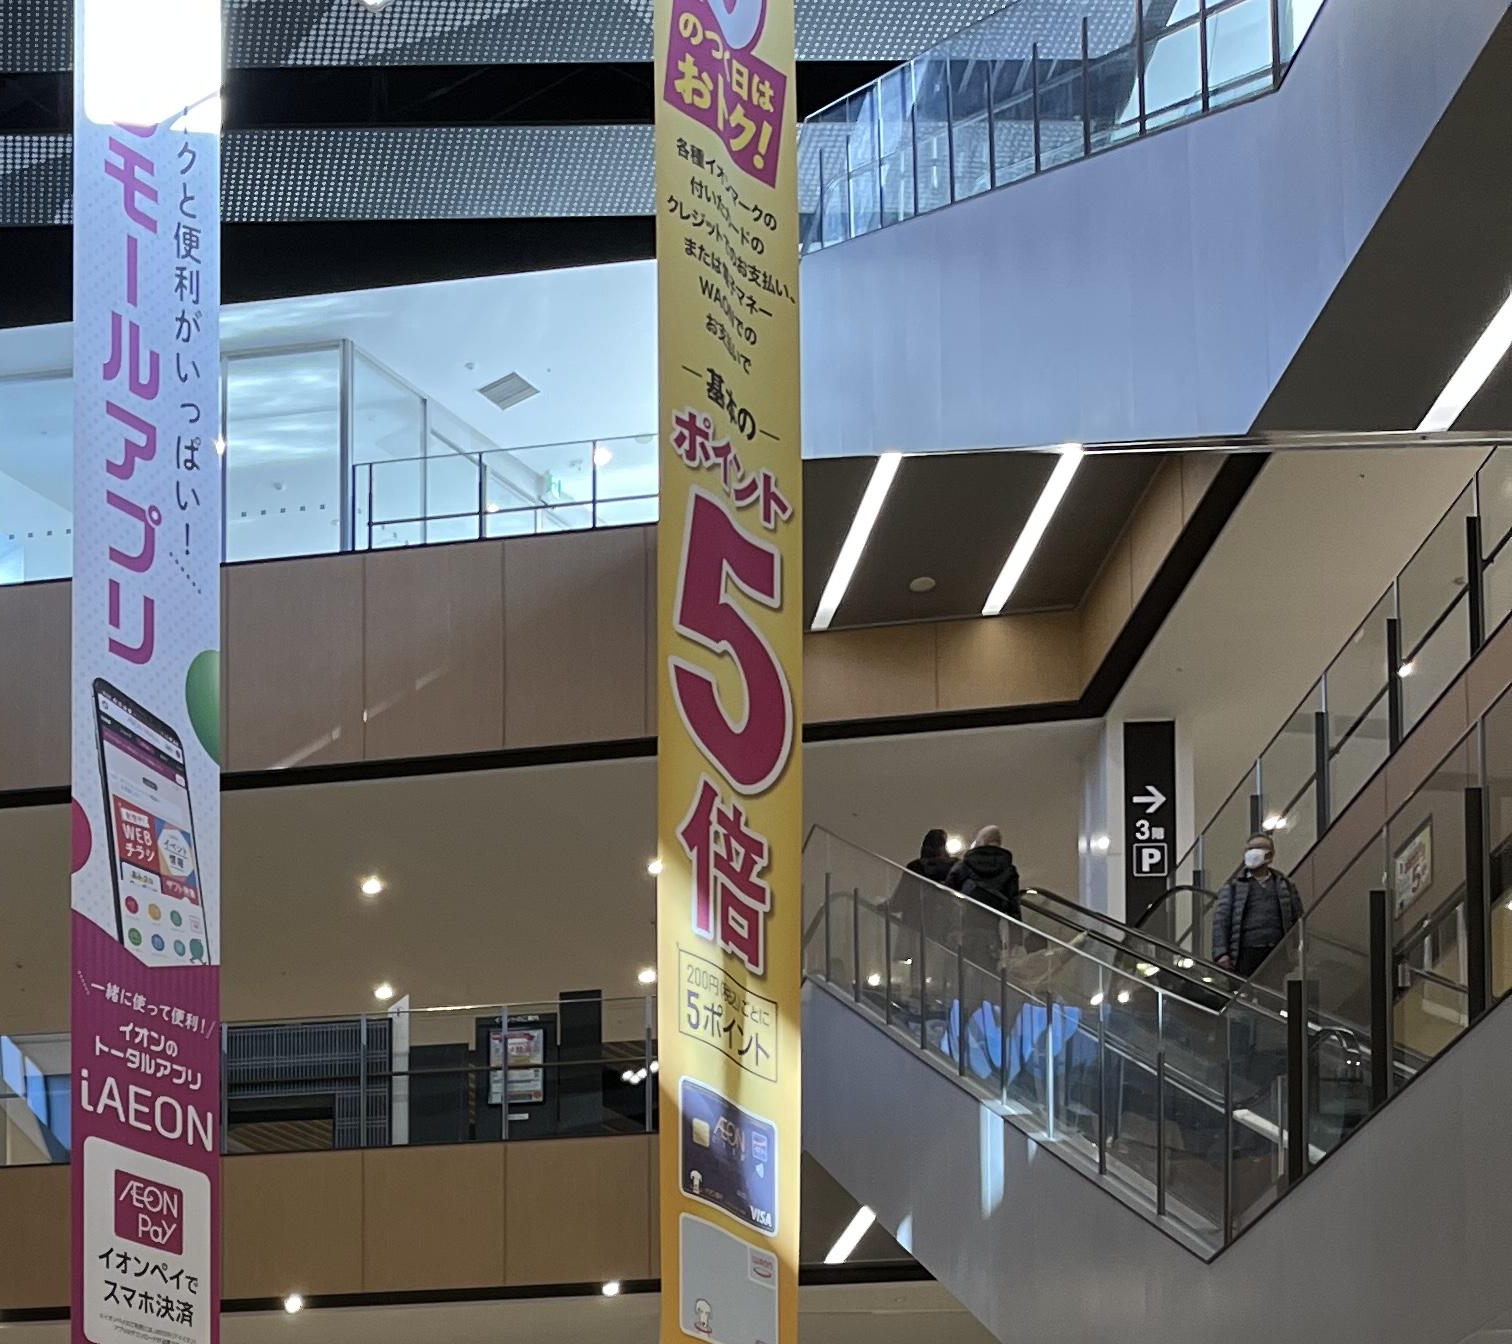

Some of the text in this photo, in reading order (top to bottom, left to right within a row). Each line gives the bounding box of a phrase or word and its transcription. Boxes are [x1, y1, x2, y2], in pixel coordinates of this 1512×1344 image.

[102, 121, 162, 665] モールアプリ
[671, 409, 792, 527] ポイント
[671, 491, 790, 791] 5
[122, 823, 153, 846] WEB
[125, 842, 155, 862] チラシ
[680, 779, 768, 969] 倍
[119, 1022, 178, 1057] イオンの
[687, 989, 770, 1066] 5ポイント
[95, 1035, 202, 1090] トータルアプリ
[81, 1068, 213, 1152] iAEON
[138, 1213, 177, 1244] Pay
[98, 1247, 199, 1294] イオンペイで
[104, 1279, 194, 1327] スマホ決済
